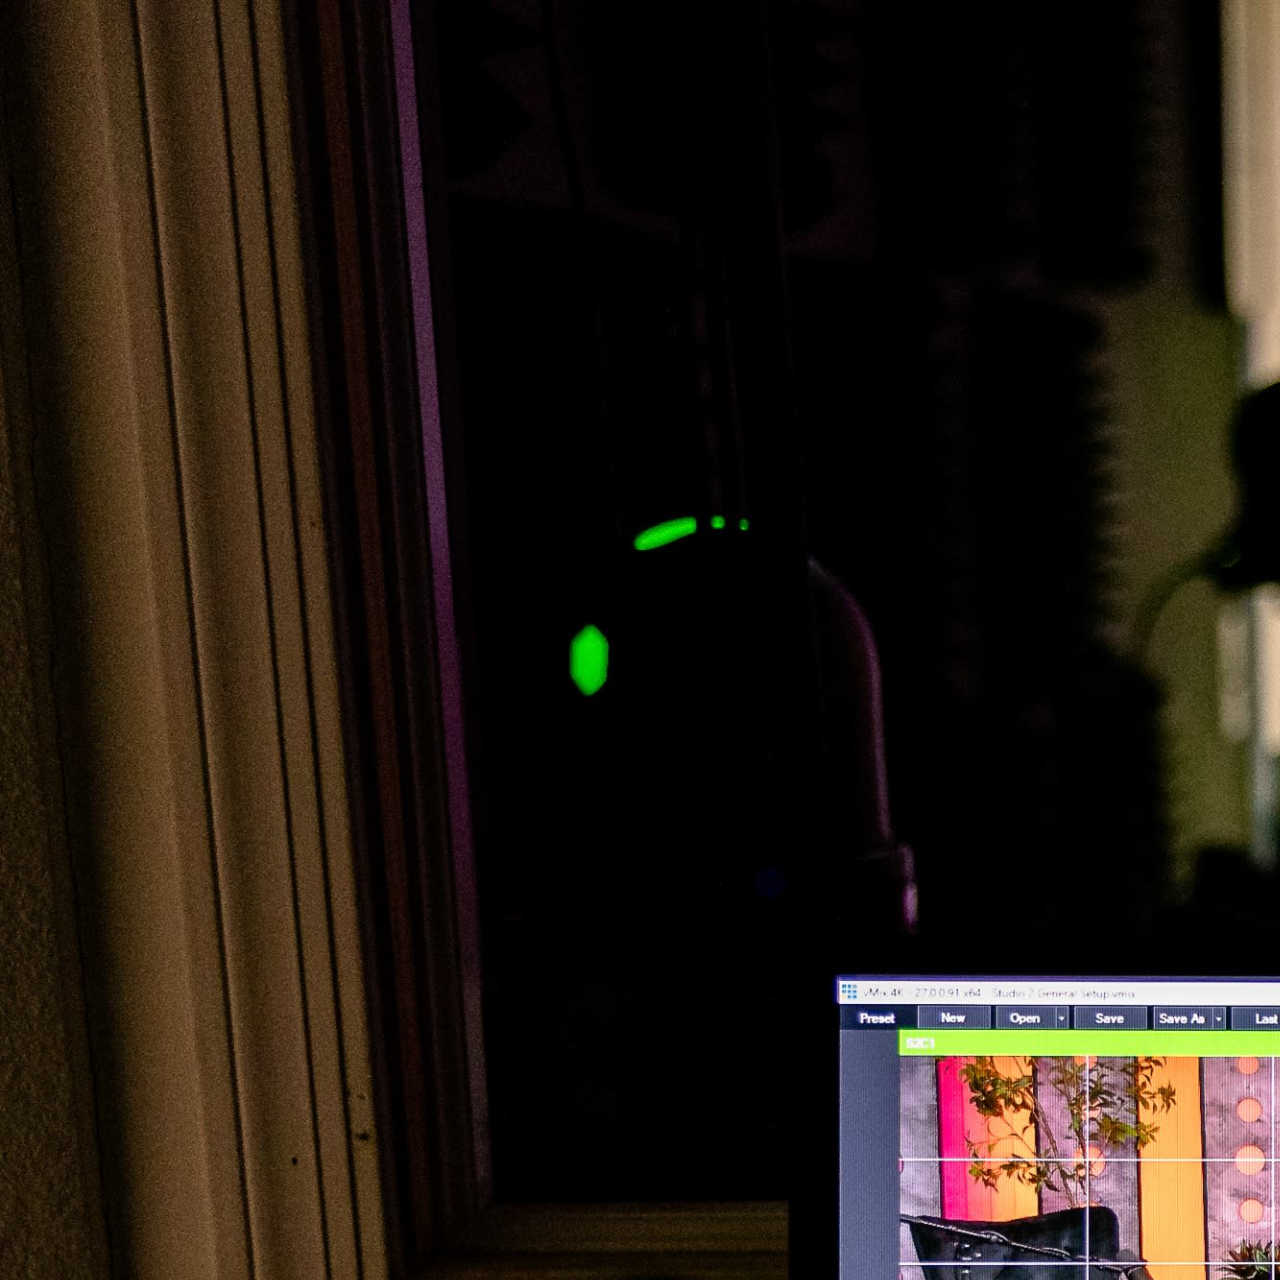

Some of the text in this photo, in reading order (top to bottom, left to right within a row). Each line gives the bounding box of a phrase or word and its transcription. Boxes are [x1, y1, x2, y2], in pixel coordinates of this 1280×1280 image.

[860, 1013, 895, 1024] Preset
[941, 1013, 965, 1023] New
[1010, 1013, 1040, 1025] Open
[1096, 1013, 1124, 1024] Save
[1160, 1013, 1205, 1024] Save As
[1255, 1014, 1278, 1024] Last
